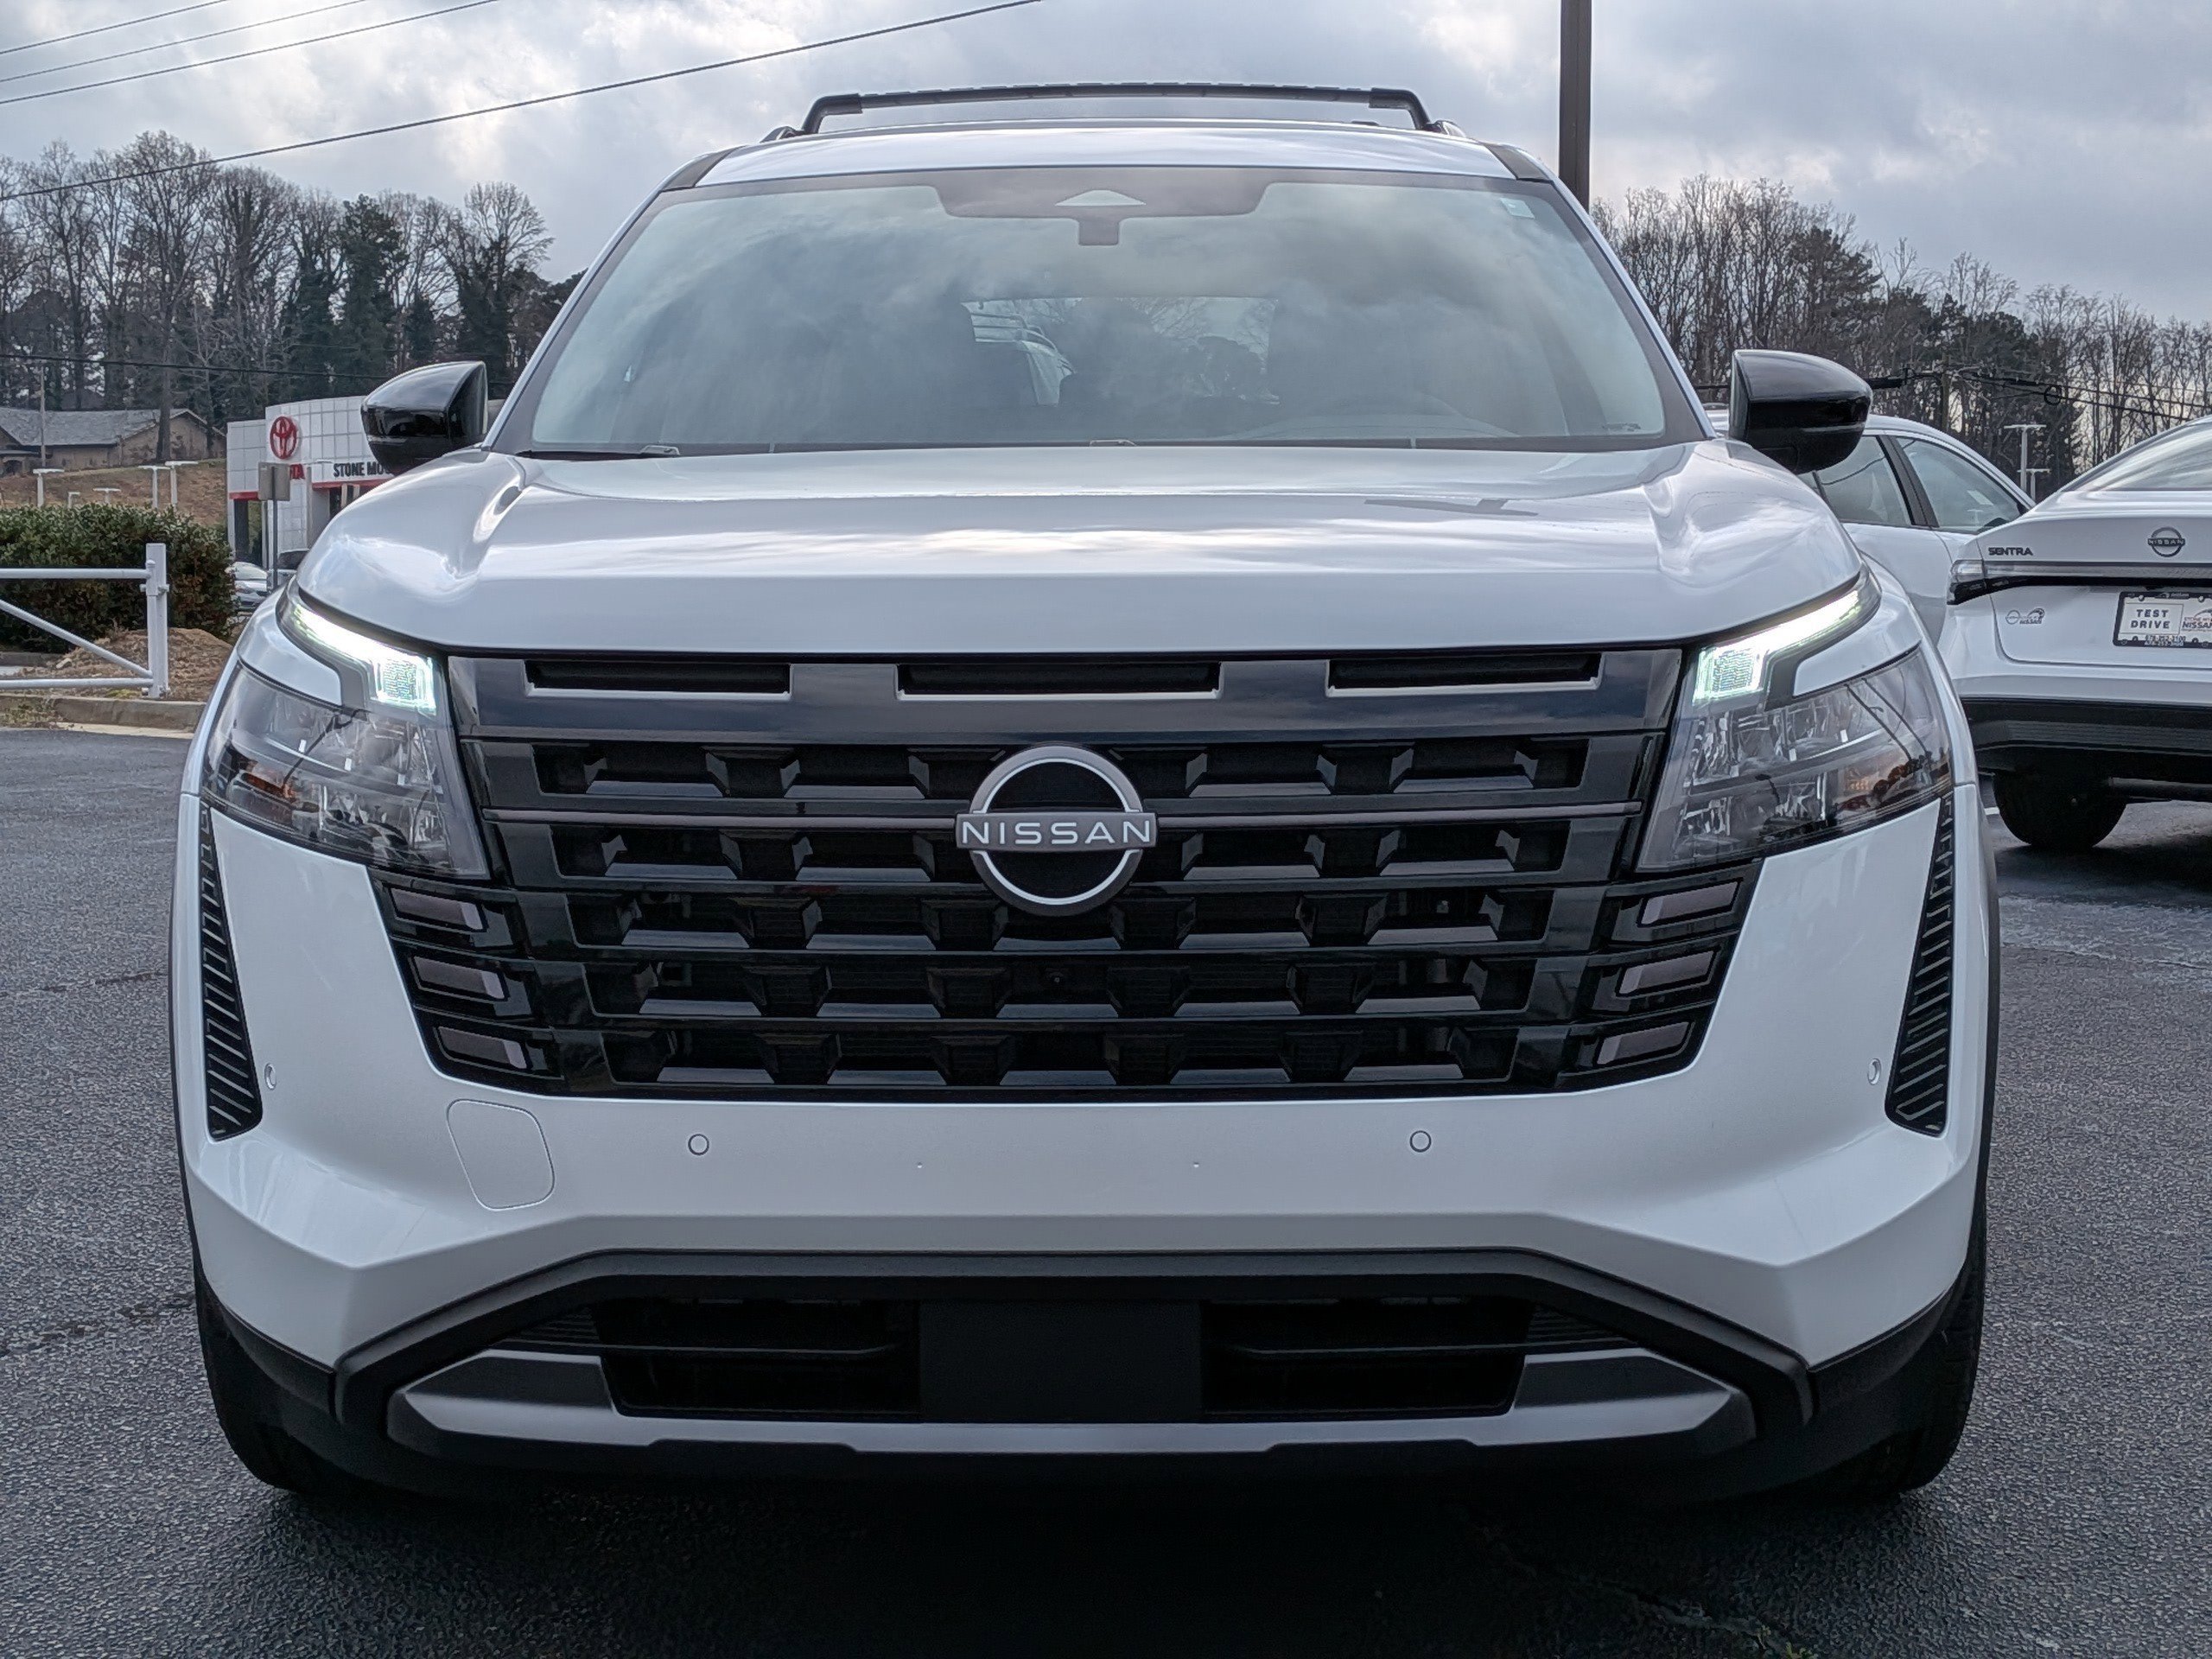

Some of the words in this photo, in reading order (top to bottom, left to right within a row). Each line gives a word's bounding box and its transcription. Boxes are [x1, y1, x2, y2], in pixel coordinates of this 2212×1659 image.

[333, 462, 365, 477] STONE
[1988, 547, 2033, 556] SENTRA
[2136, 609, 2169, 618] TEST
[2131, 620, 2171, 629] DRIVE
[962, 820, 1150, 845] NISSAN
